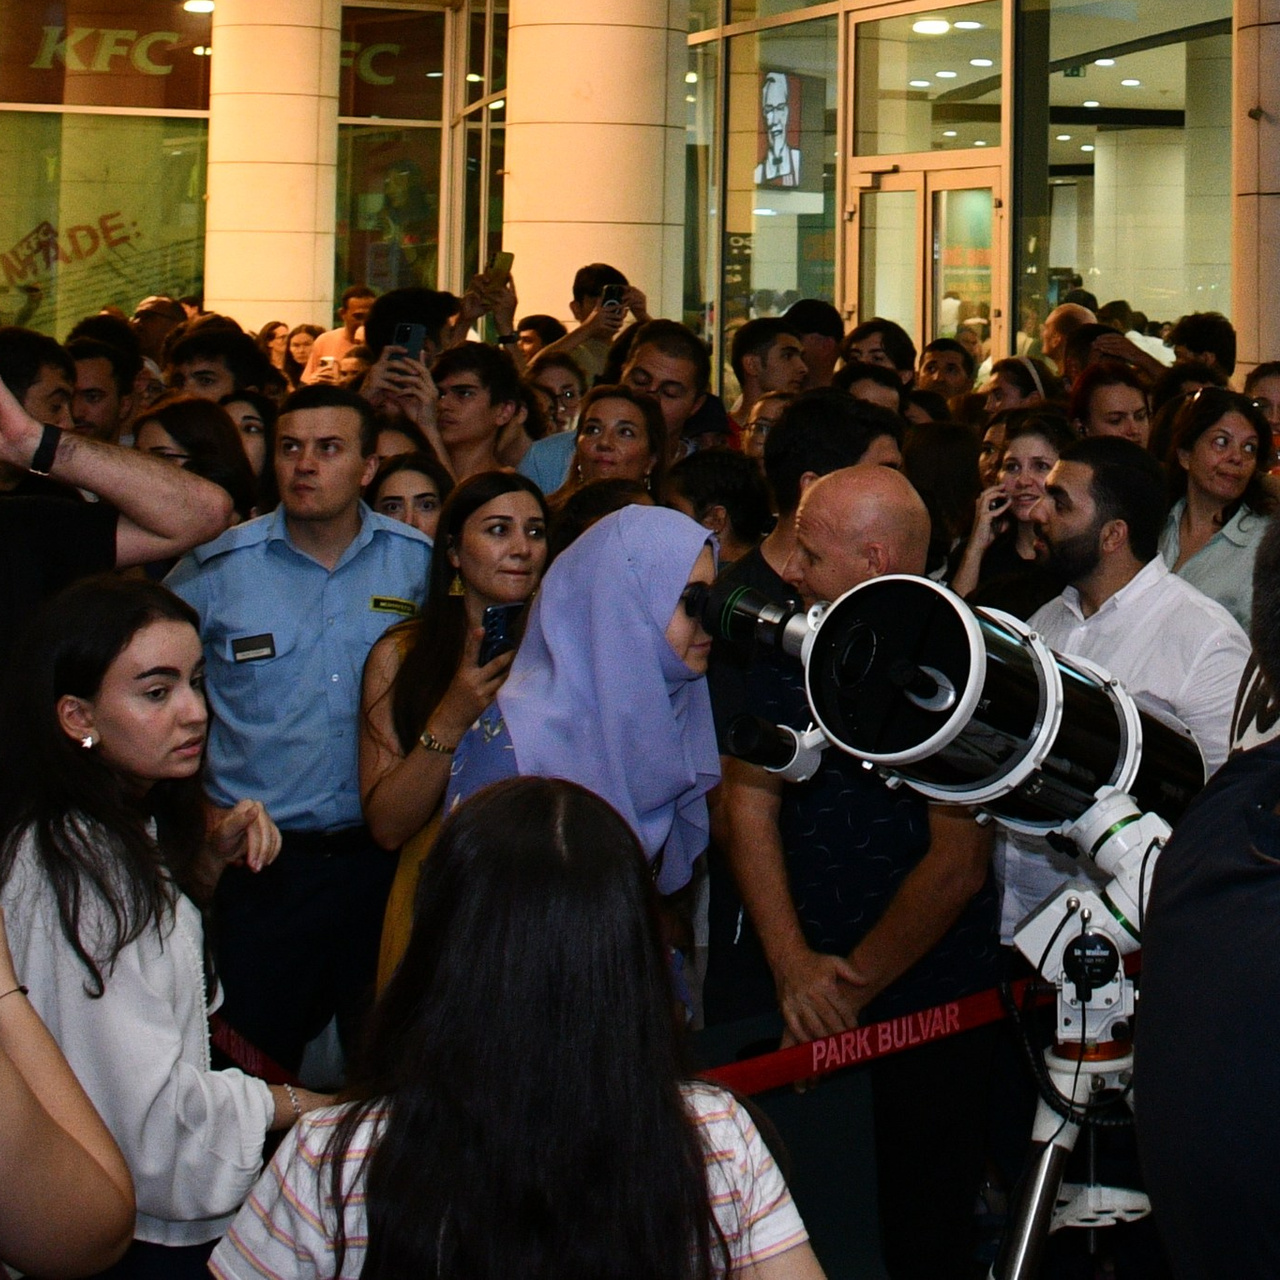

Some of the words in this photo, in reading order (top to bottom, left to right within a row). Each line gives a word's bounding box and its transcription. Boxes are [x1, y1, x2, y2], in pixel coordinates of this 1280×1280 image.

[30, 26, 181, 76] KFC
[812, 1026, 872, 1072] PARK
[877, 1002, 960, 1054] BULVAR
